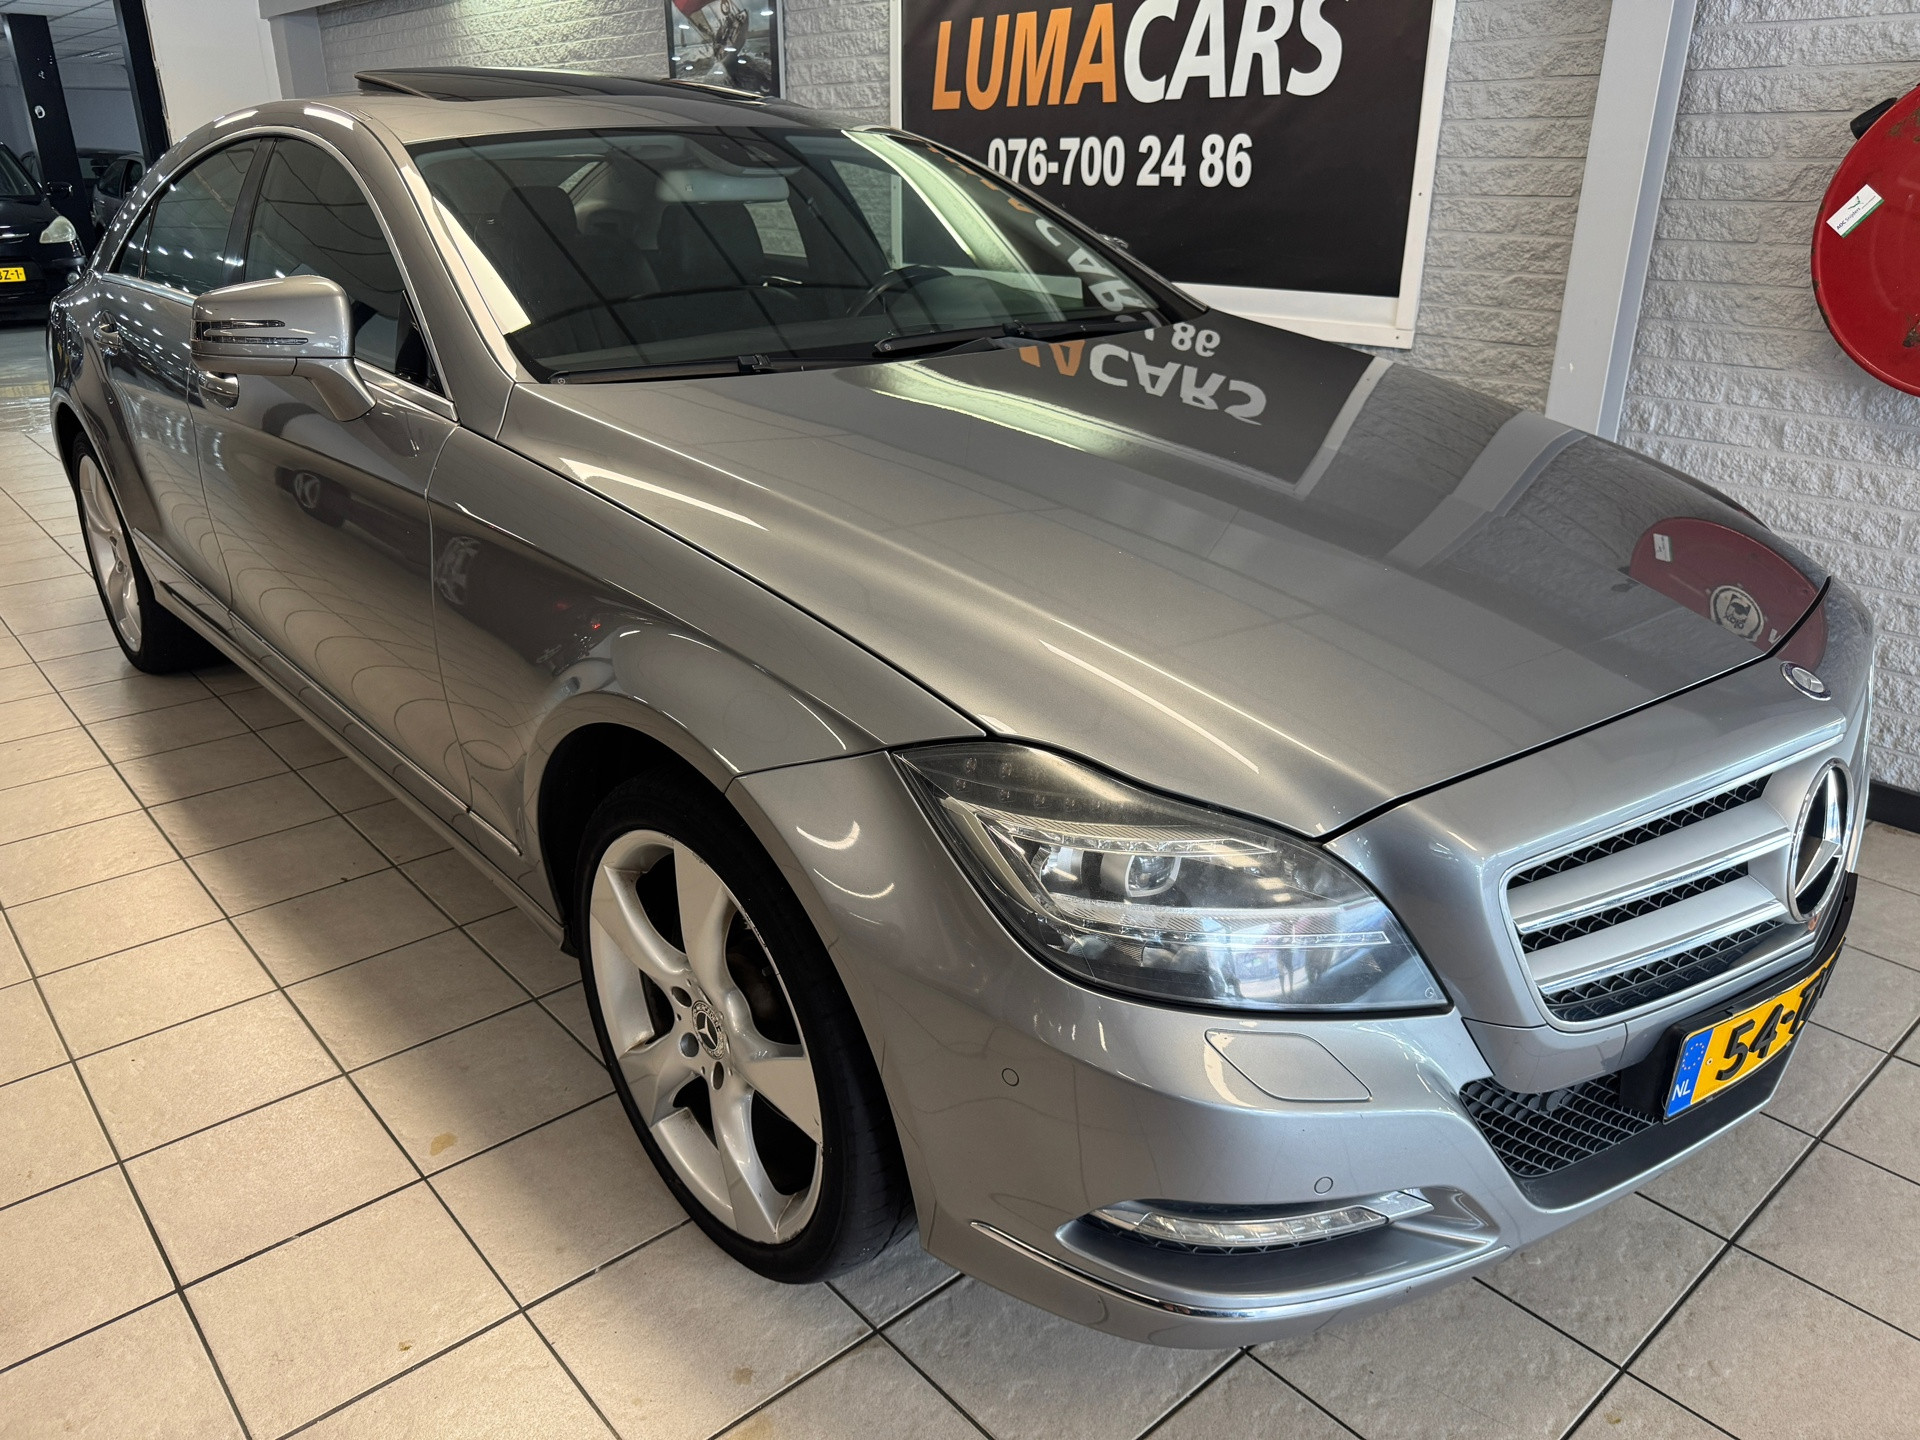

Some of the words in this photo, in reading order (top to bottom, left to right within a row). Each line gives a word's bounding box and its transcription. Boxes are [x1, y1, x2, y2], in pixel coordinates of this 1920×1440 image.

[932, 0, 1343, 110] LUMACARS
[988, 135, 1125, 187] 076-700
[1136, 134, 1186, 187] 24
[1199, 133, 1252, 188] 86
[1671, 1079, 1691, 1101] NL
